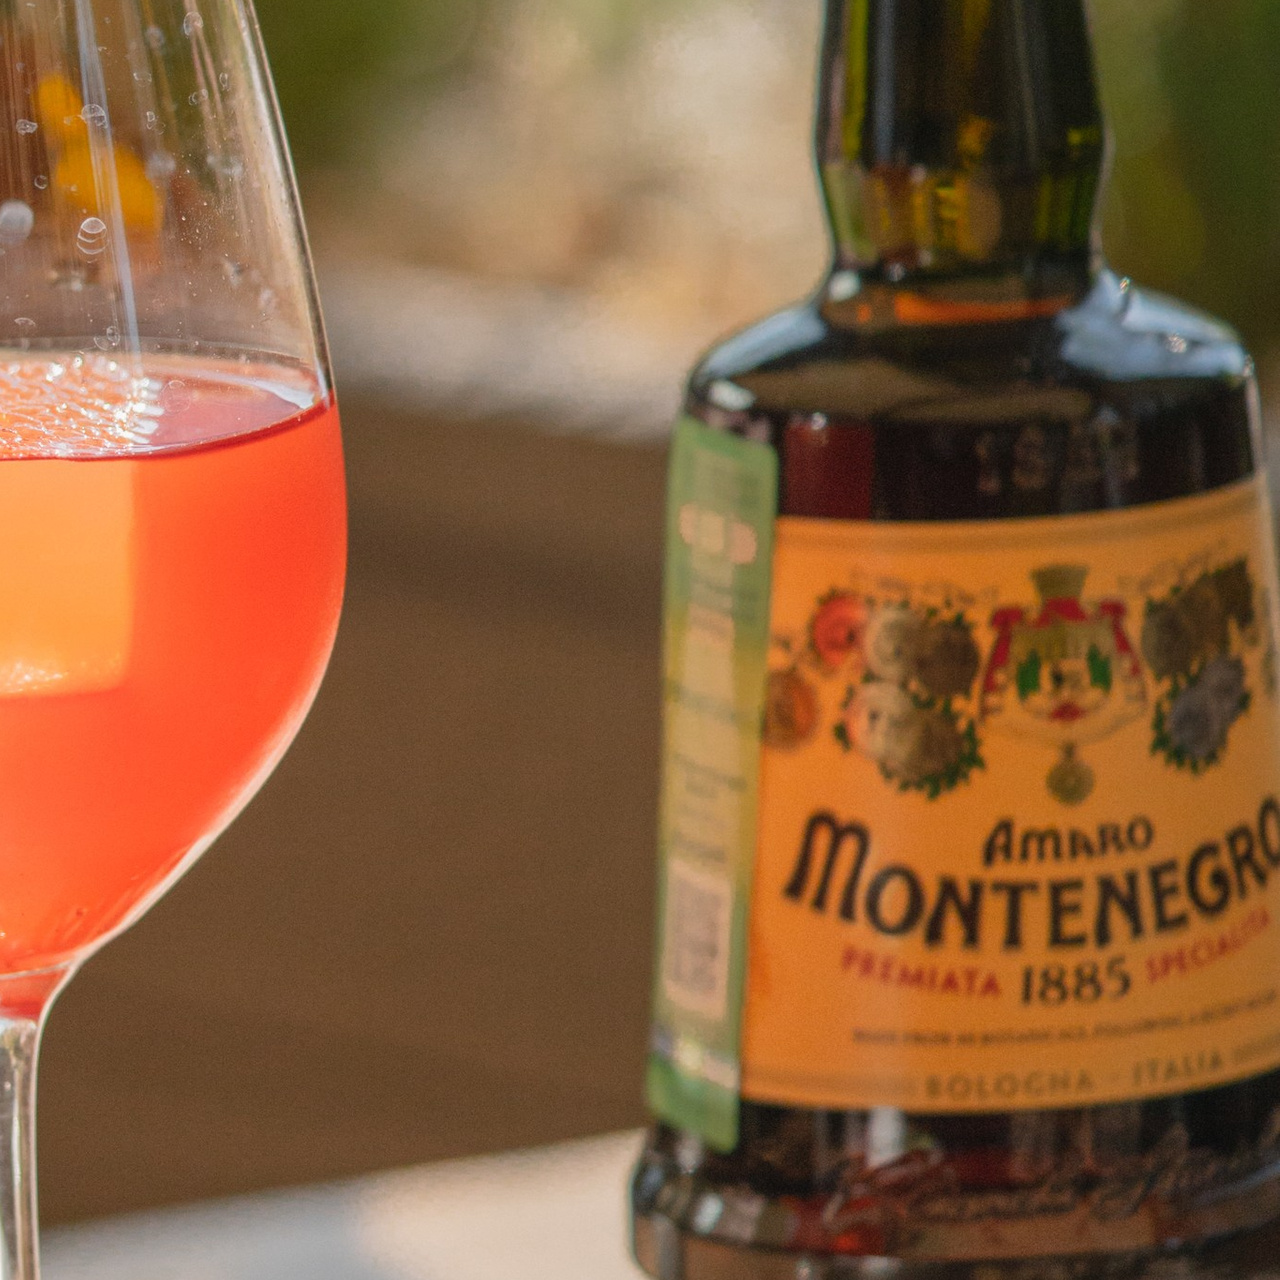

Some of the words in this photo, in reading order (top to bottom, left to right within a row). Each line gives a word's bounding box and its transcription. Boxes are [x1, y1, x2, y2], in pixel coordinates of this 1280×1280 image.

[783, 794, 1280, 952] MONTENEGRO
[841, 945, 1002, 998] PREMIATA
[1020, 958, 1132, 1006] 1885
[925, 1069, 1095, 1100] BOLOGNA
[1132, 1050, 1223, 1087] ITALIA
